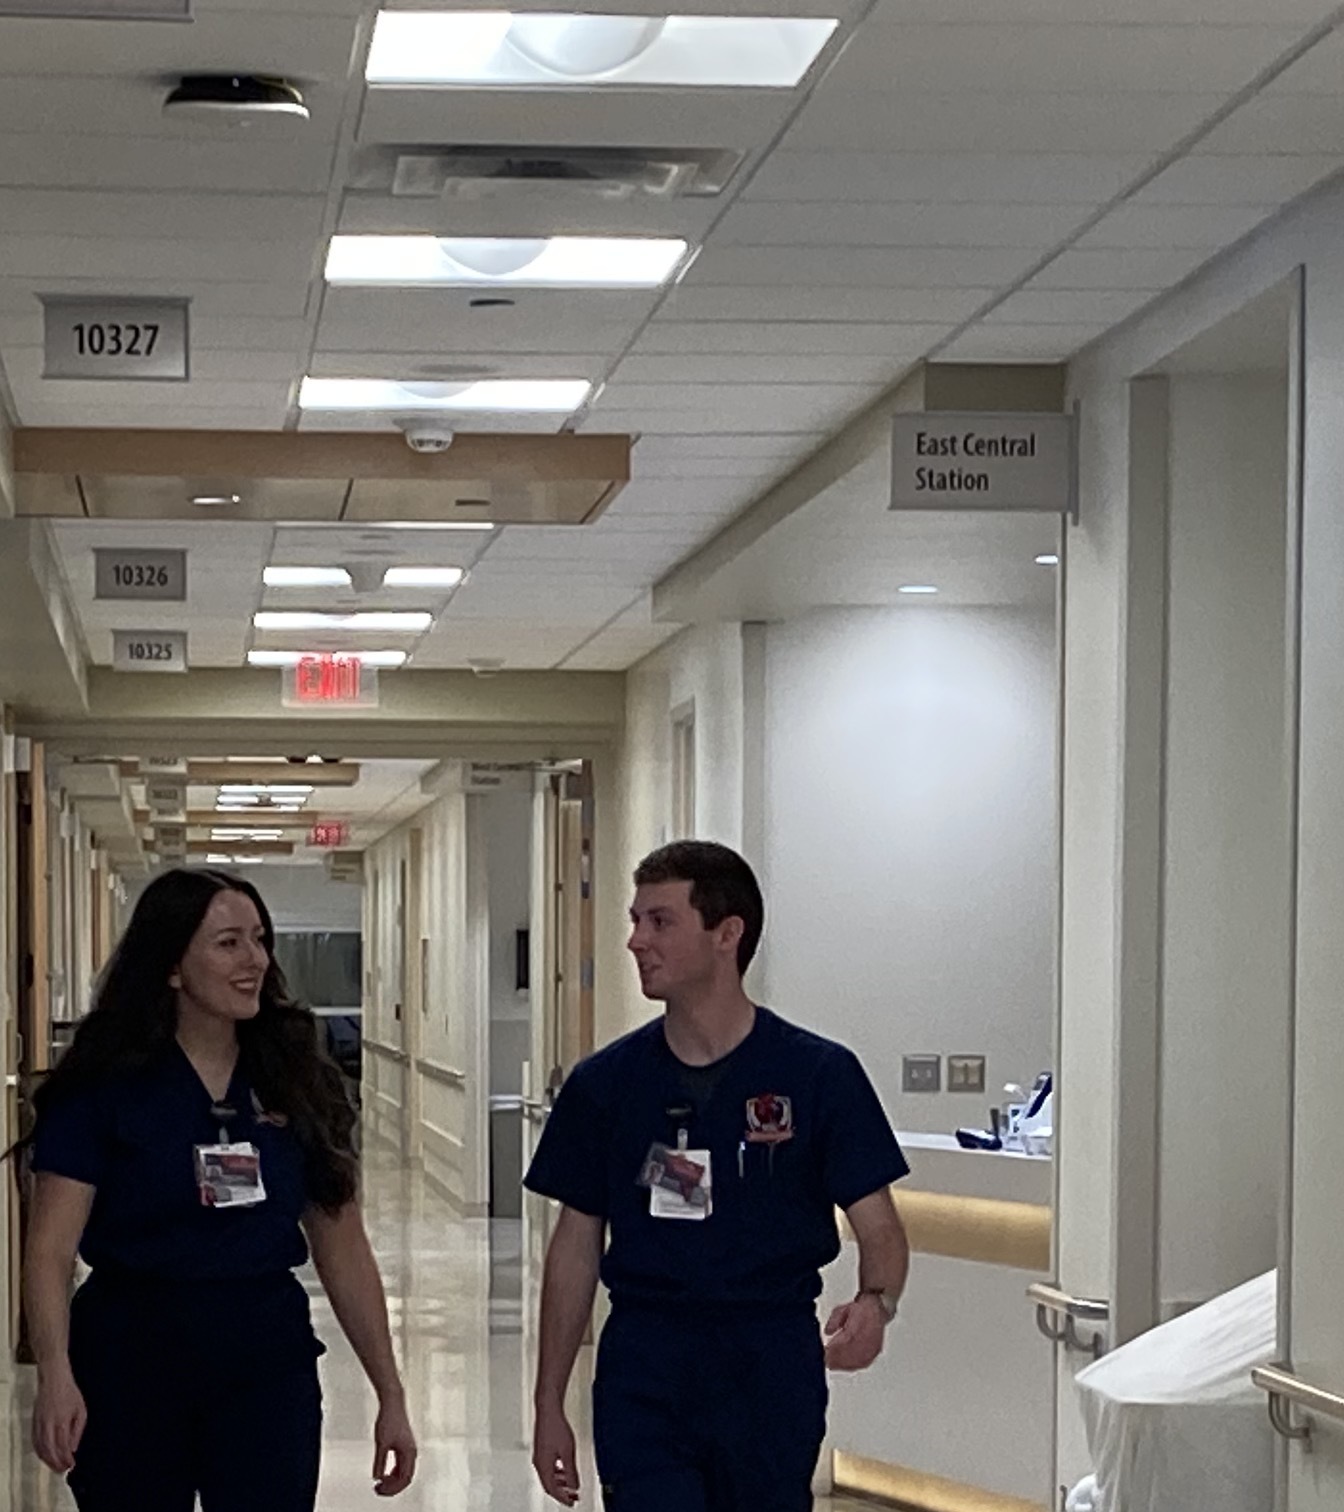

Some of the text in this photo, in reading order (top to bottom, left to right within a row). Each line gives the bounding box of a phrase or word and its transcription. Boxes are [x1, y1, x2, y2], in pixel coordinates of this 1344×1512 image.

[72, 323, 160, 356] 10327
[915, 432, 1035, 457] East Central
[915, 467, 989, 491] Station
[113, 565, 168, 587] 10326
[128, 642, 172, 660] 10325
